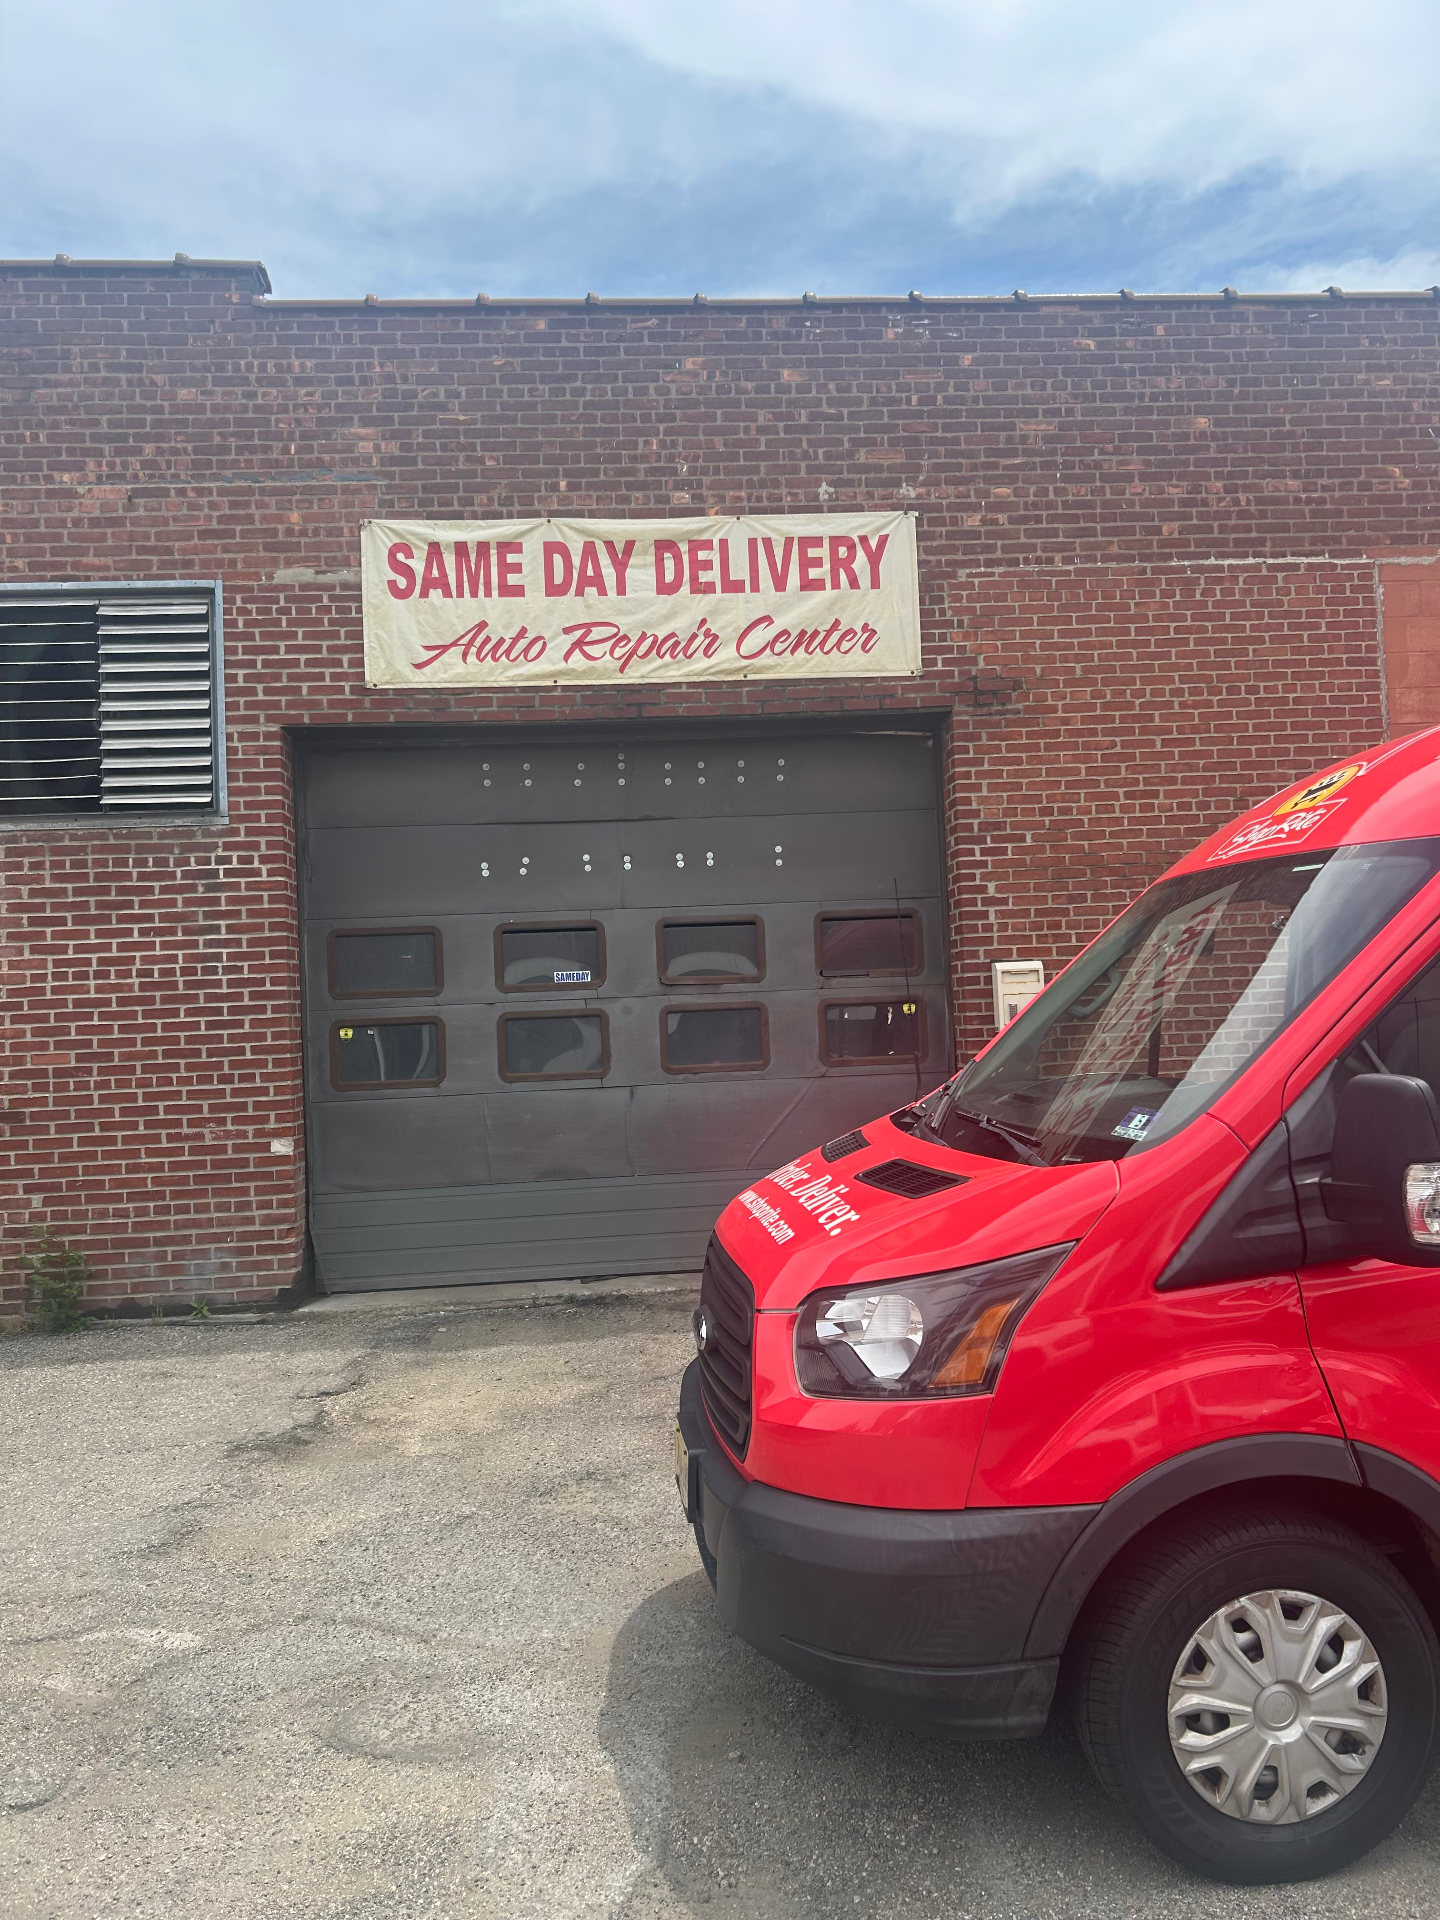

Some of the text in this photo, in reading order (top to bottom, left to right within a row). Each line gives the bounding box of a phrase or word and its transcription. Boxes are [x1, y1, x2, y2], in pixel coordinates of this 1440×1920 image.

[387, 533, 890, 600] SAME DAY DELIVERY
[410, 615, 881, 673] Auto Repair Center
[555, 971, 590, 982] SAMEDAY
[789, 1174, 861, 1236] Deliver.
